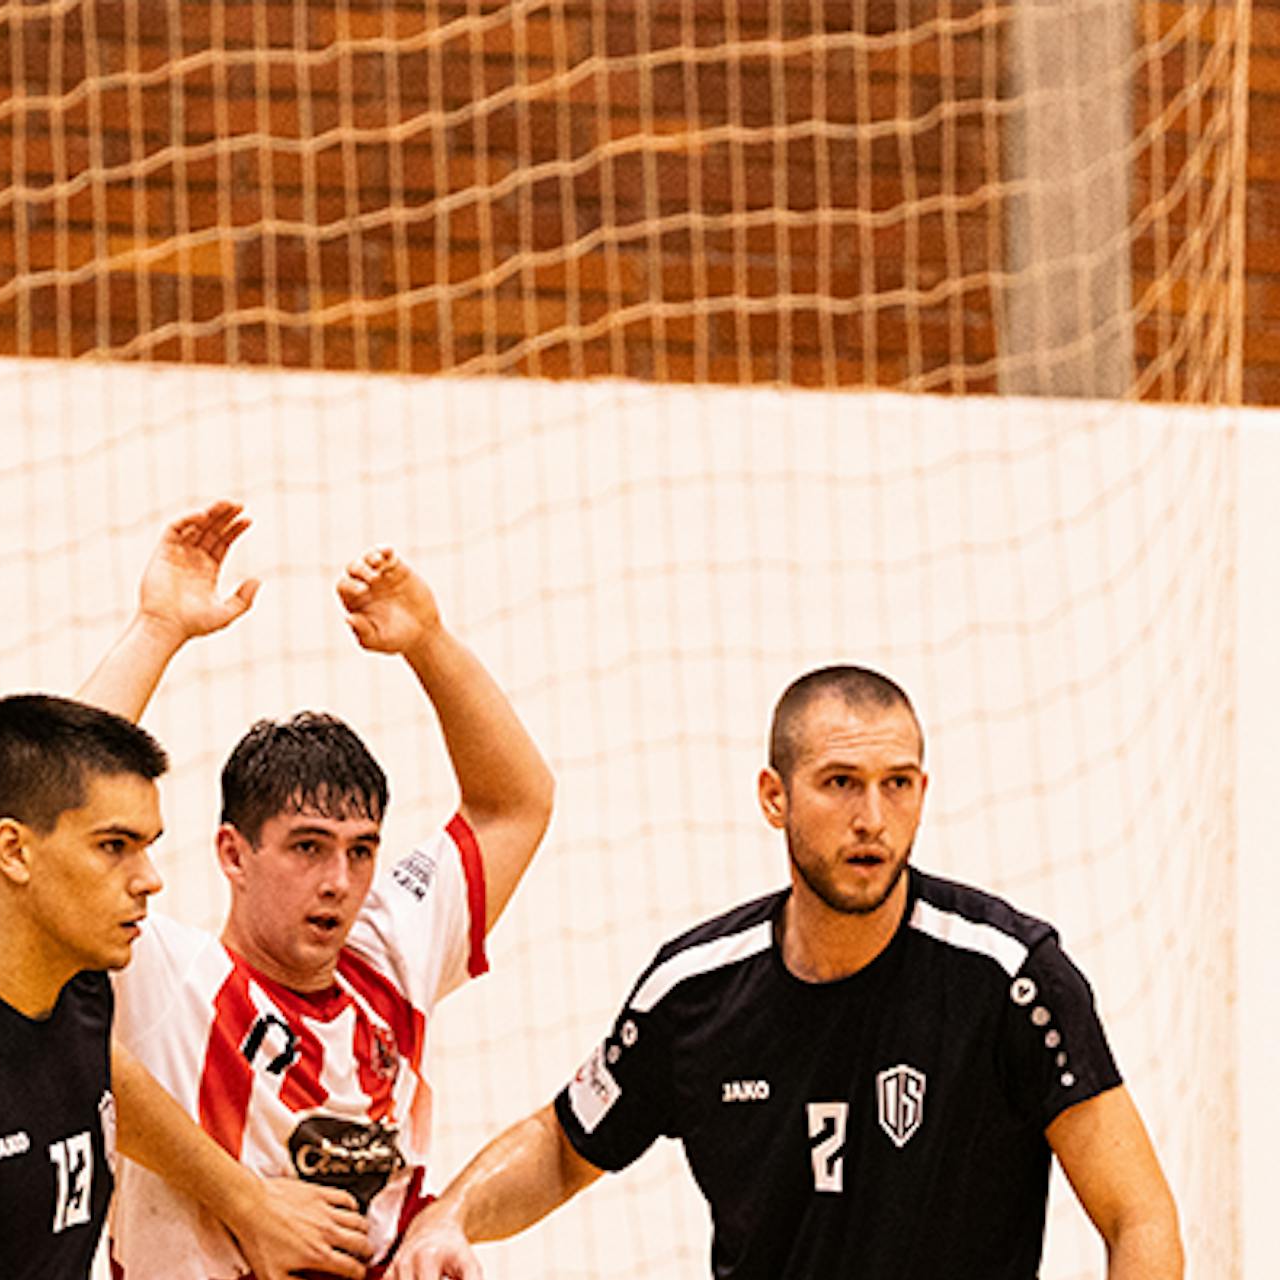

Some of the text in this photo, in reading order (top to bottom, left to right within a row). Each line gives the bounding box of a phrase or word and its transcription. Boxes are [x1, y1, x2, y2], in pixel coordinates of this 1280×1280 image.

[722, 1079, 769, 1102] JAKO
[49, 1131, 91, 1233] 13
[806, 1102, 849, 1192] 2
